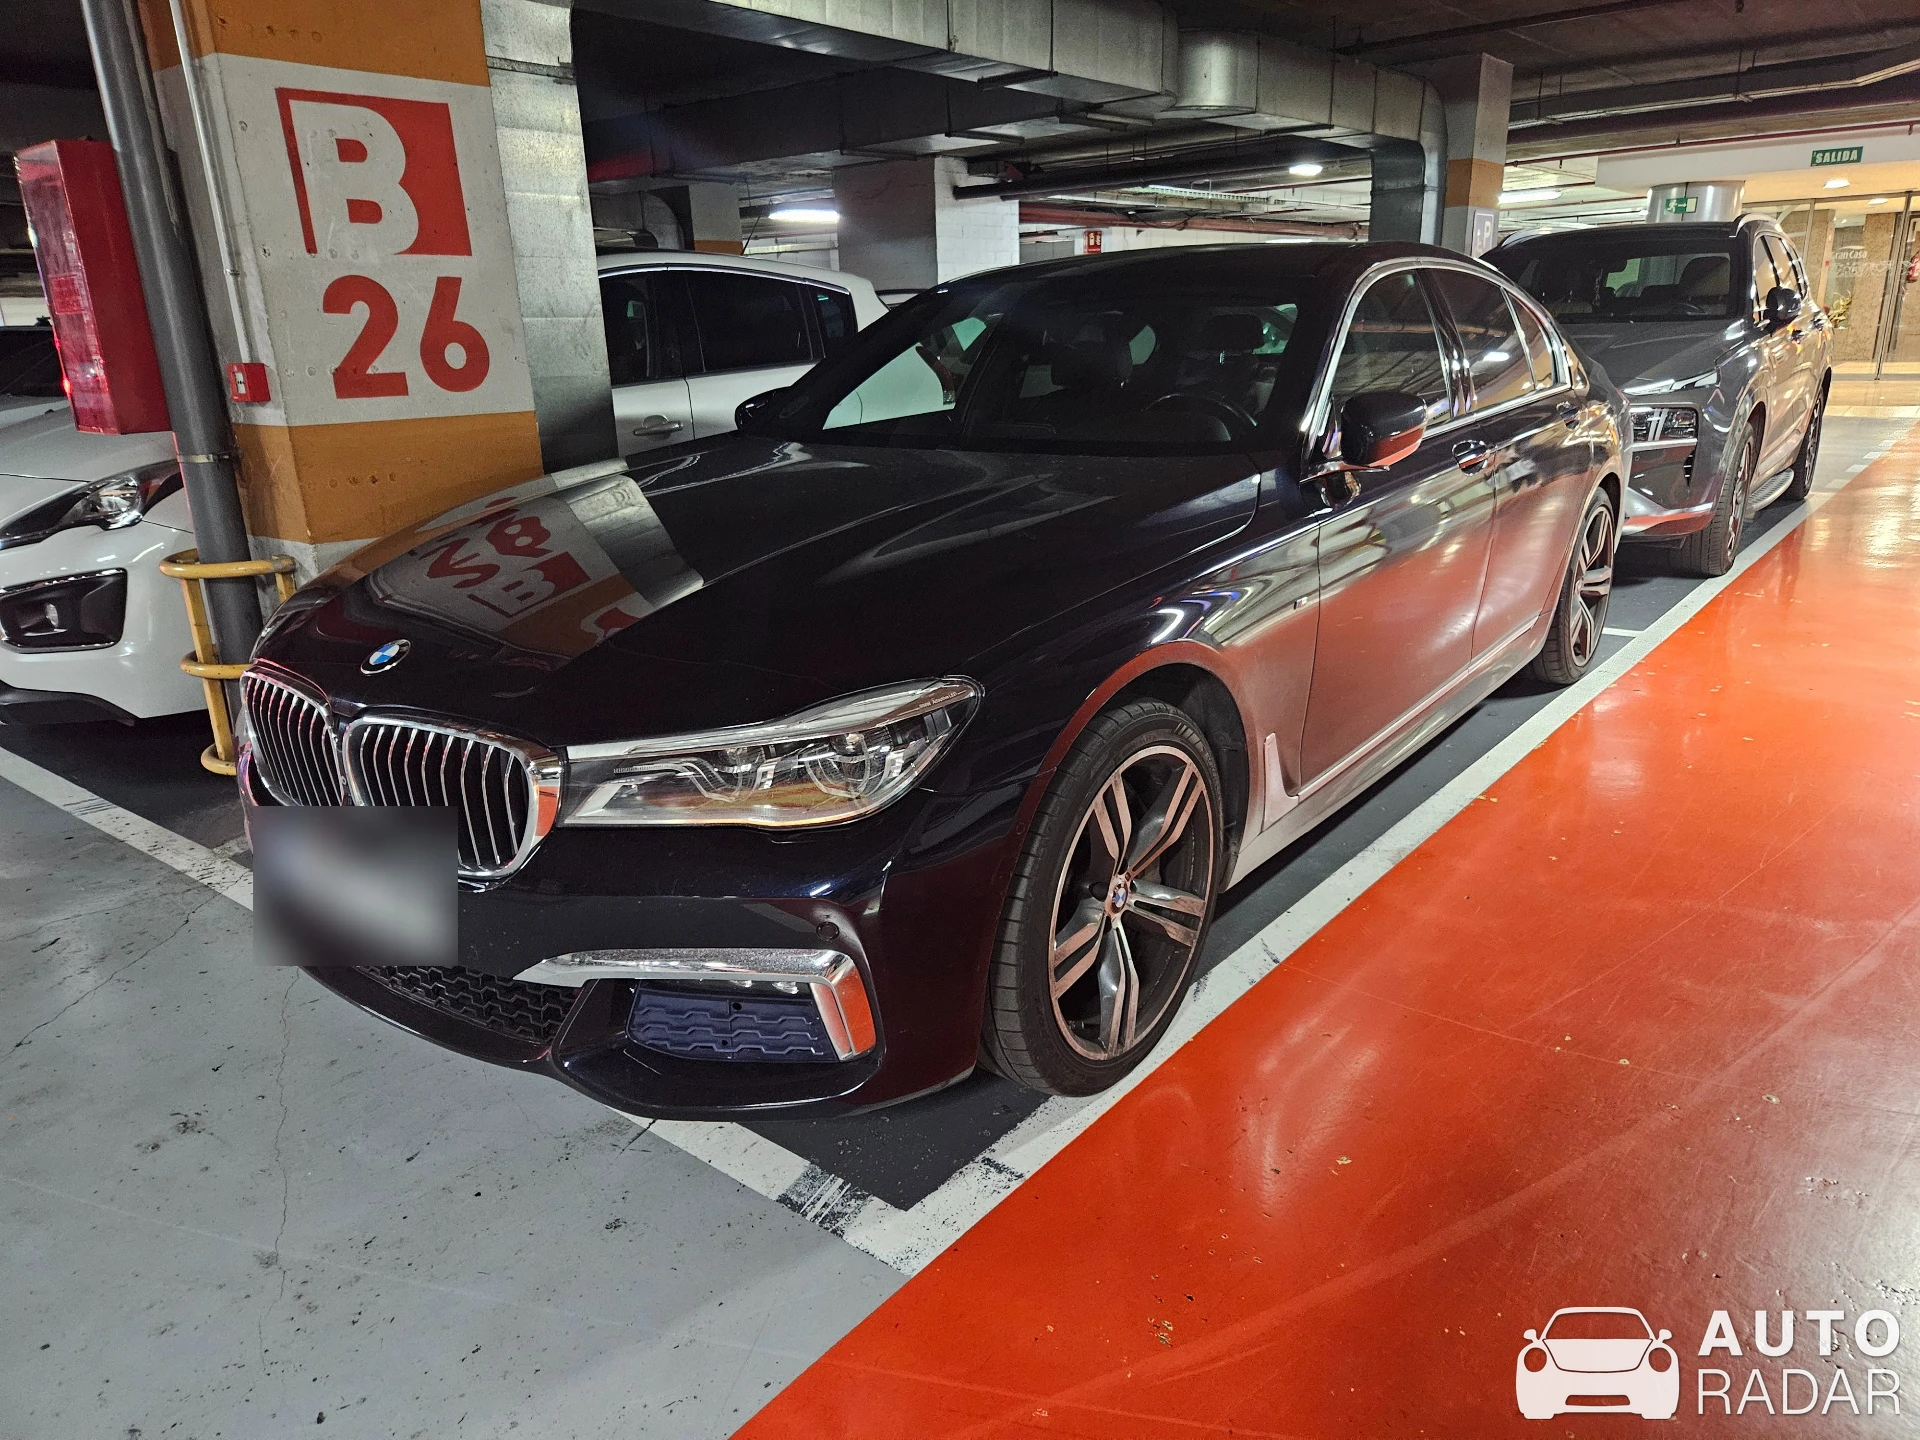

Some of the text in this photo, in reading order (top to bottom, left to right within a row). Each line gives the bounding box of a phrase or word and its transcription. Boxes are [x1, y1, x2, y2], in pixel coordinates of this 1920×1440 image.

[1815, 149, 1858, 164] SALIDA
[288, 99, 419, 255] B
[1483, 221, 1491, 249] P
[1849, 250, 1868, 259] Casa
[322, 274, 490, 400] 26
